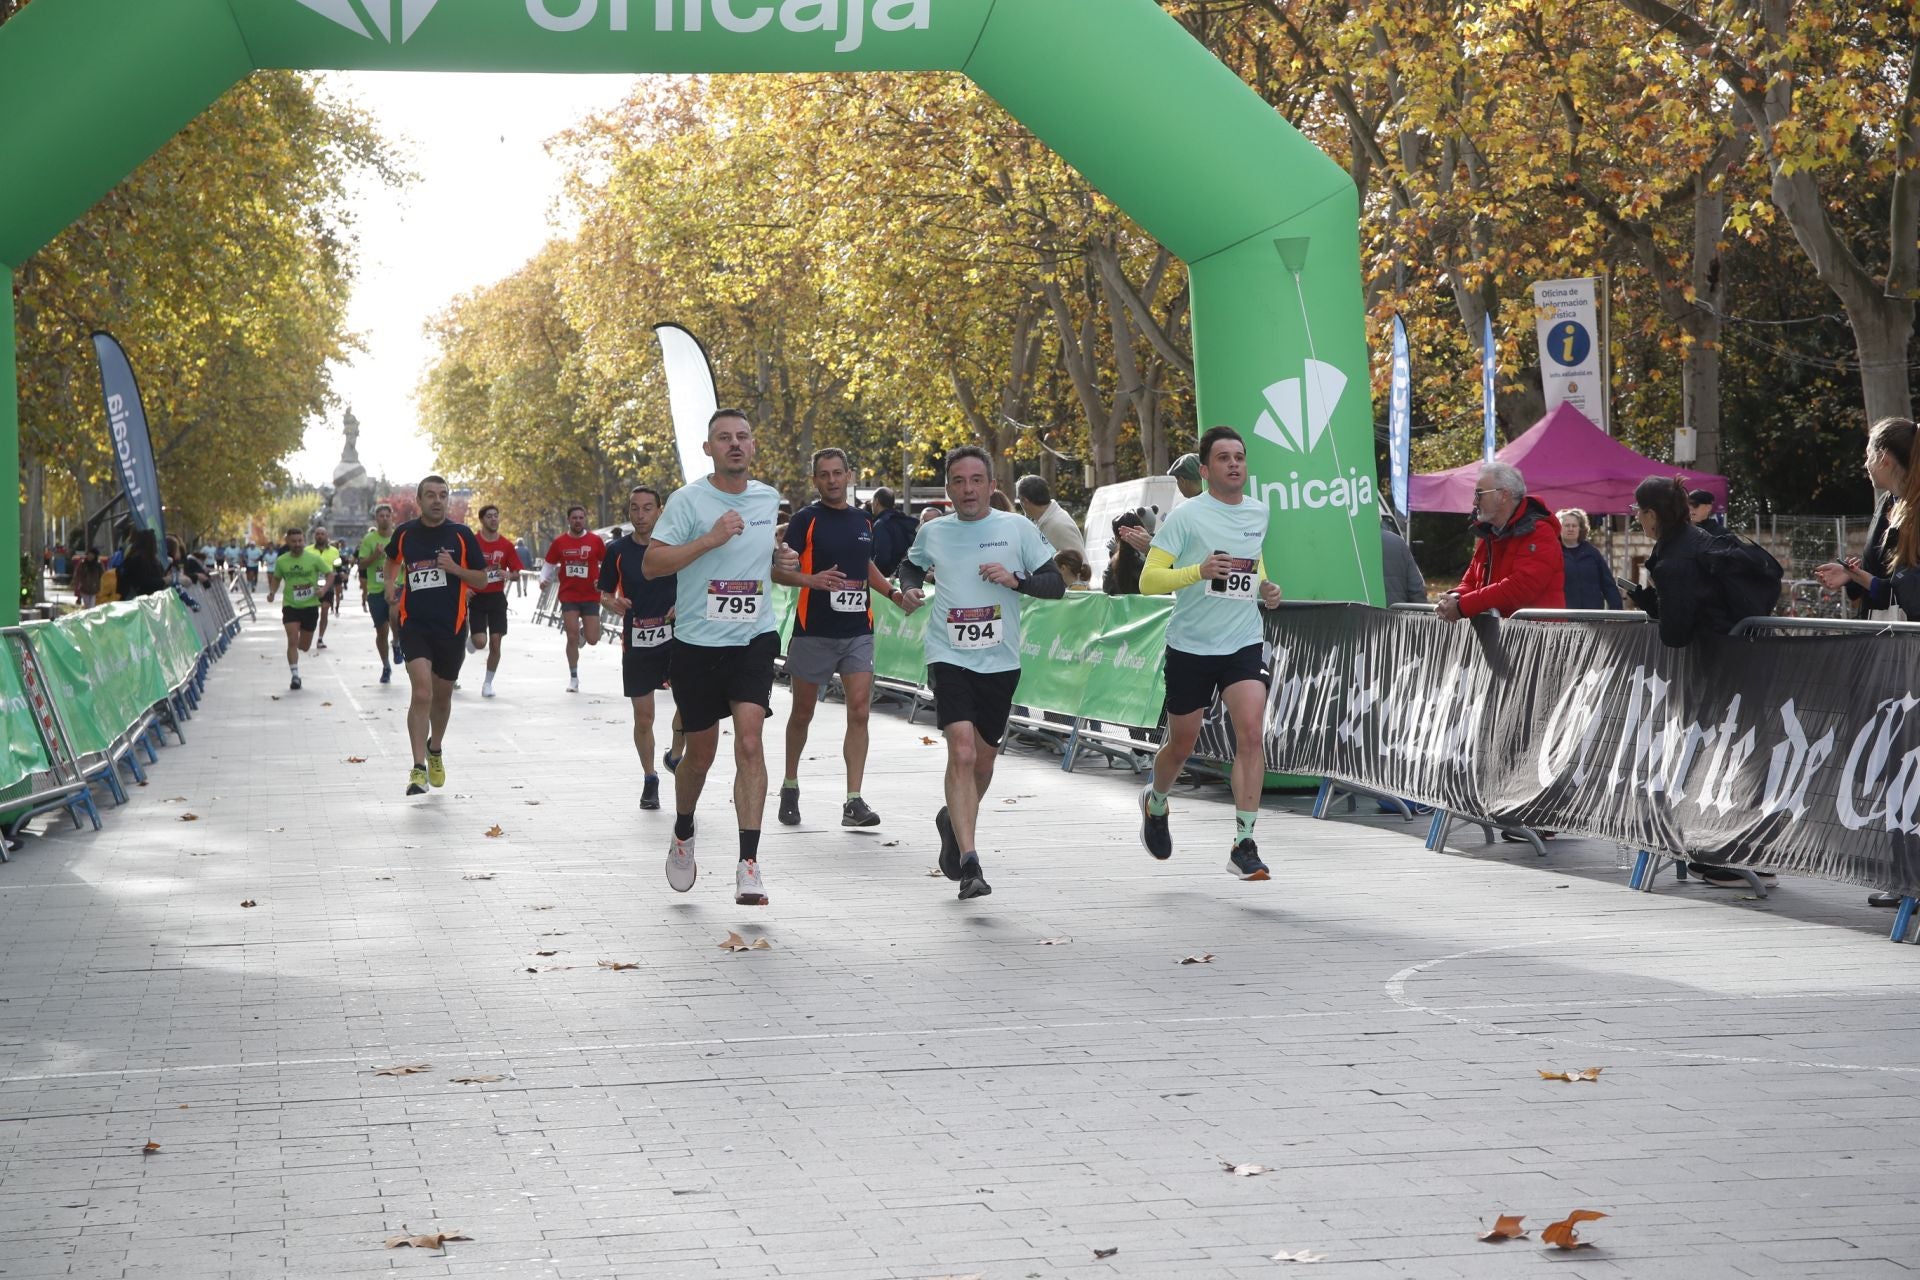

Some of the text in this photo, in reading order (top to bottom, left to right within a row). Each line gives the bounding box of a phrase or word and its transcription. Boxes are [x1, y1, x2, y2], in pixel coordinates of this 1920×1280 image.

[1542, 289, 1568, 297] Oficina
[979, 541, 1008, 549] OneHealth
[412, 570, 440, 584] 473
[567, 566, 584, 575] 343
[1228, 574, 1251, 592] 96
[716, 596, 756, 614] 795
[836, 591, 863, 606] 472
[637, 627, 666, 642] 474
[954, 622, 995, 641] 794
[1759, 697, 1834, 823] de
